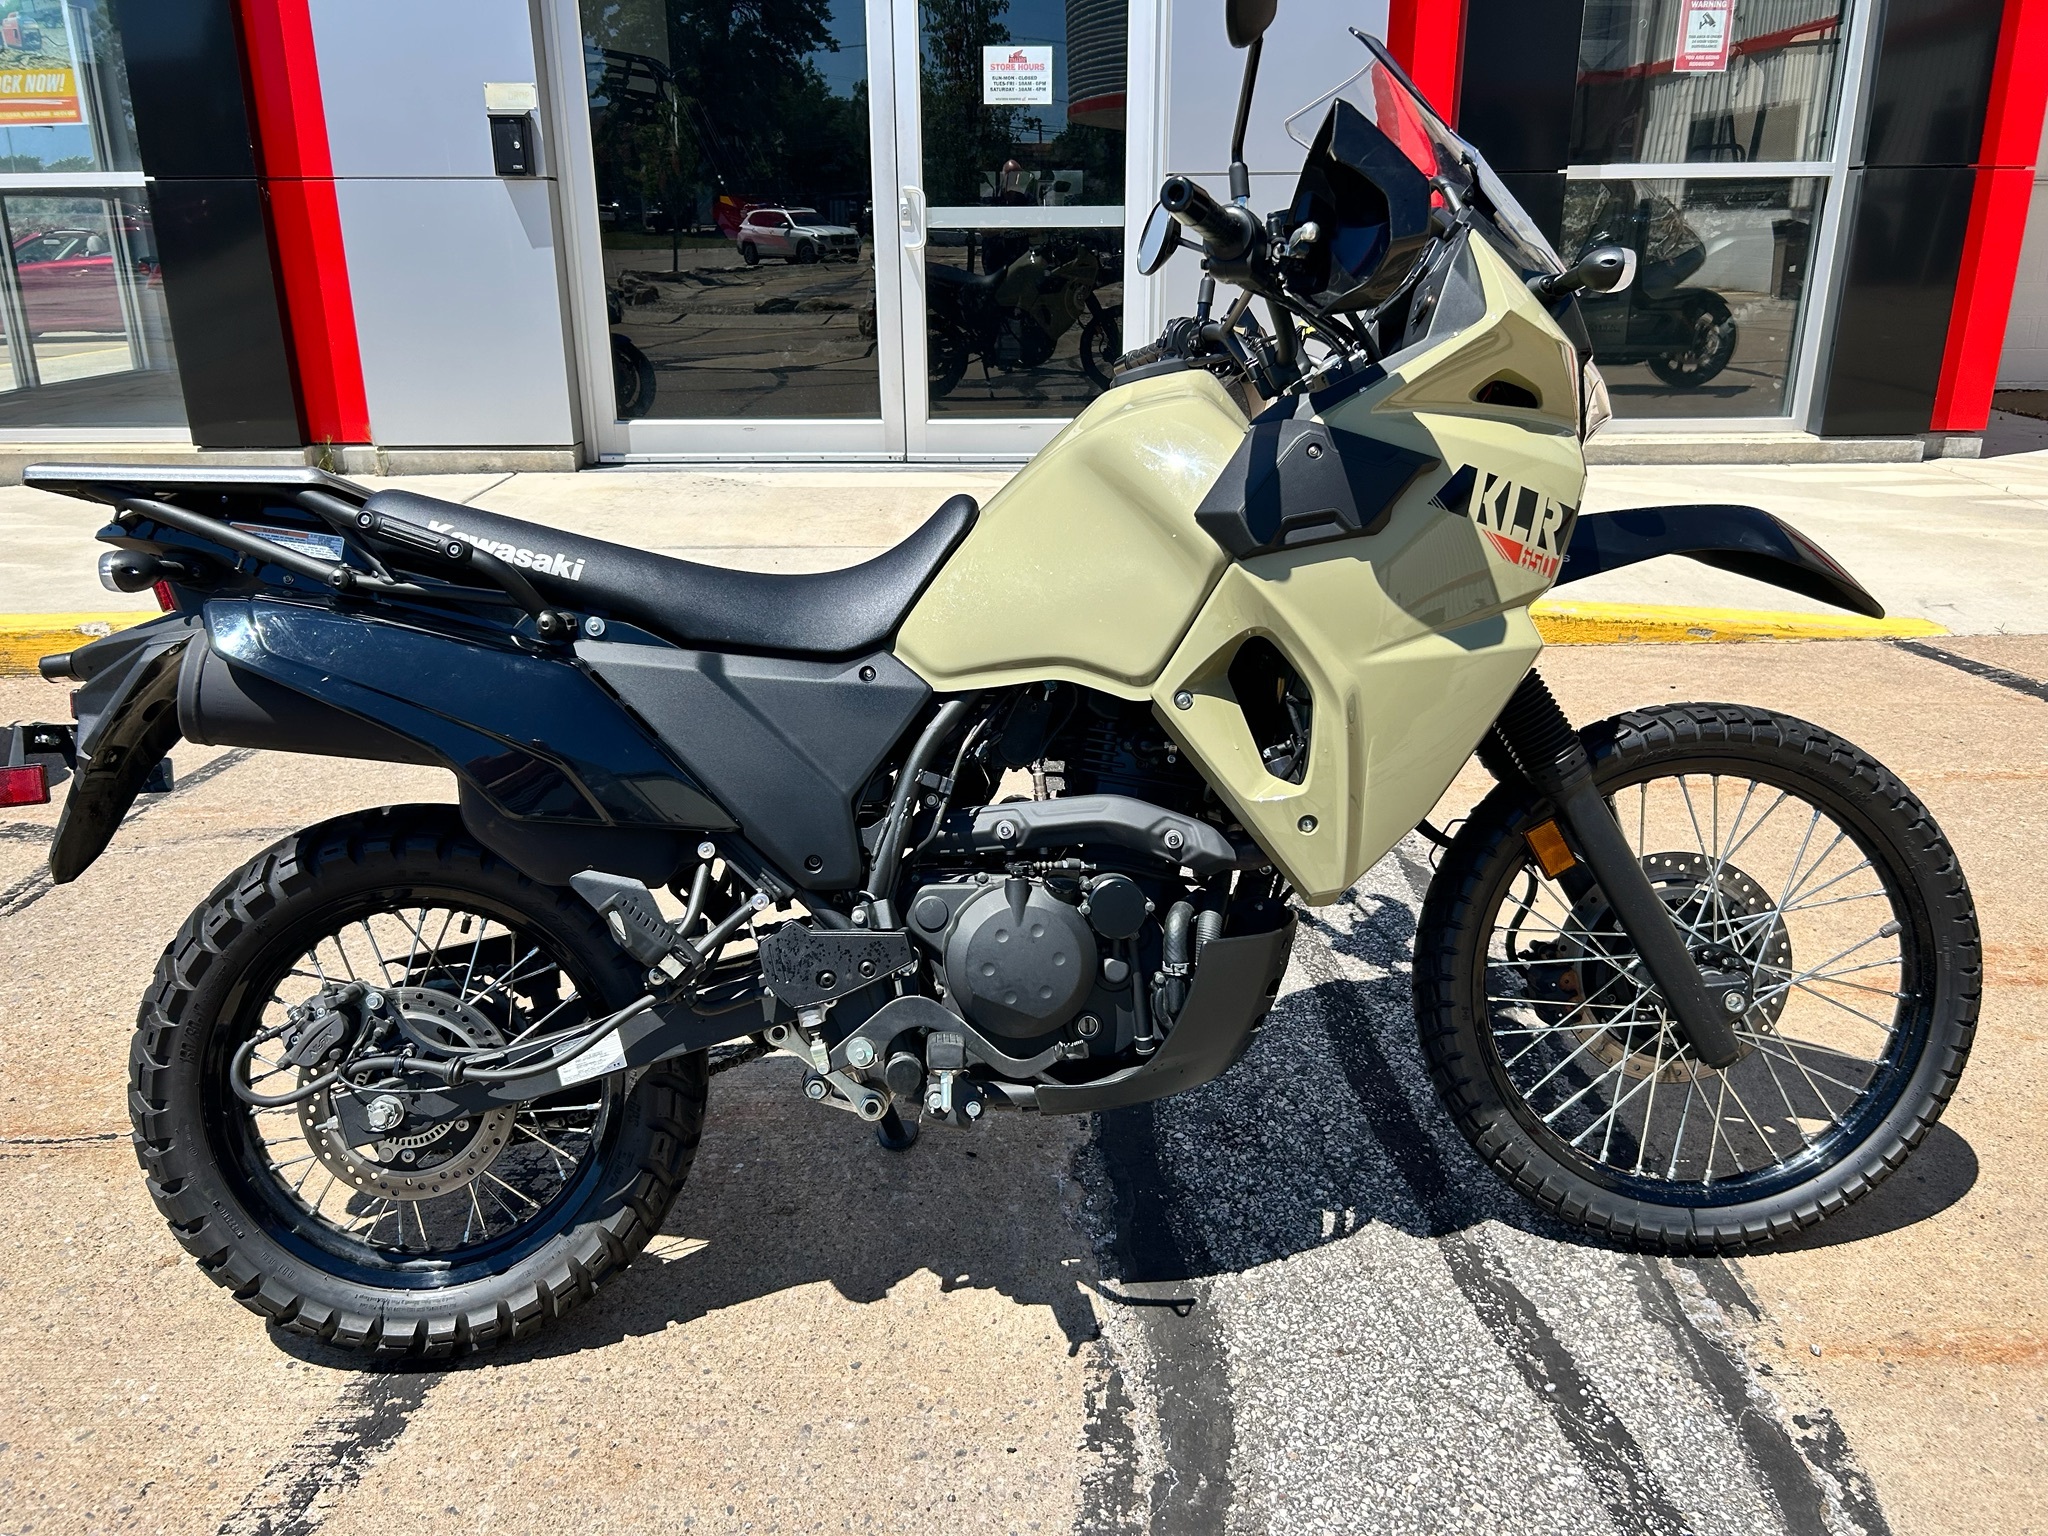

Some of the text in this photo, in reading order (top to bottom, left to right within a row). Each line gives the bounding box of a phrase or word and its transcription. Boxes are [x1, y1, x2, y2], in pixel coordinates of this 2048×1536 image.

[990, 63, 1045, 71] STORE HOURS
[0, 73, 66, 94] CK NOW!
[1468, 466, 1563, 556] KLR
[1518, 547, 1555, 579] 650
